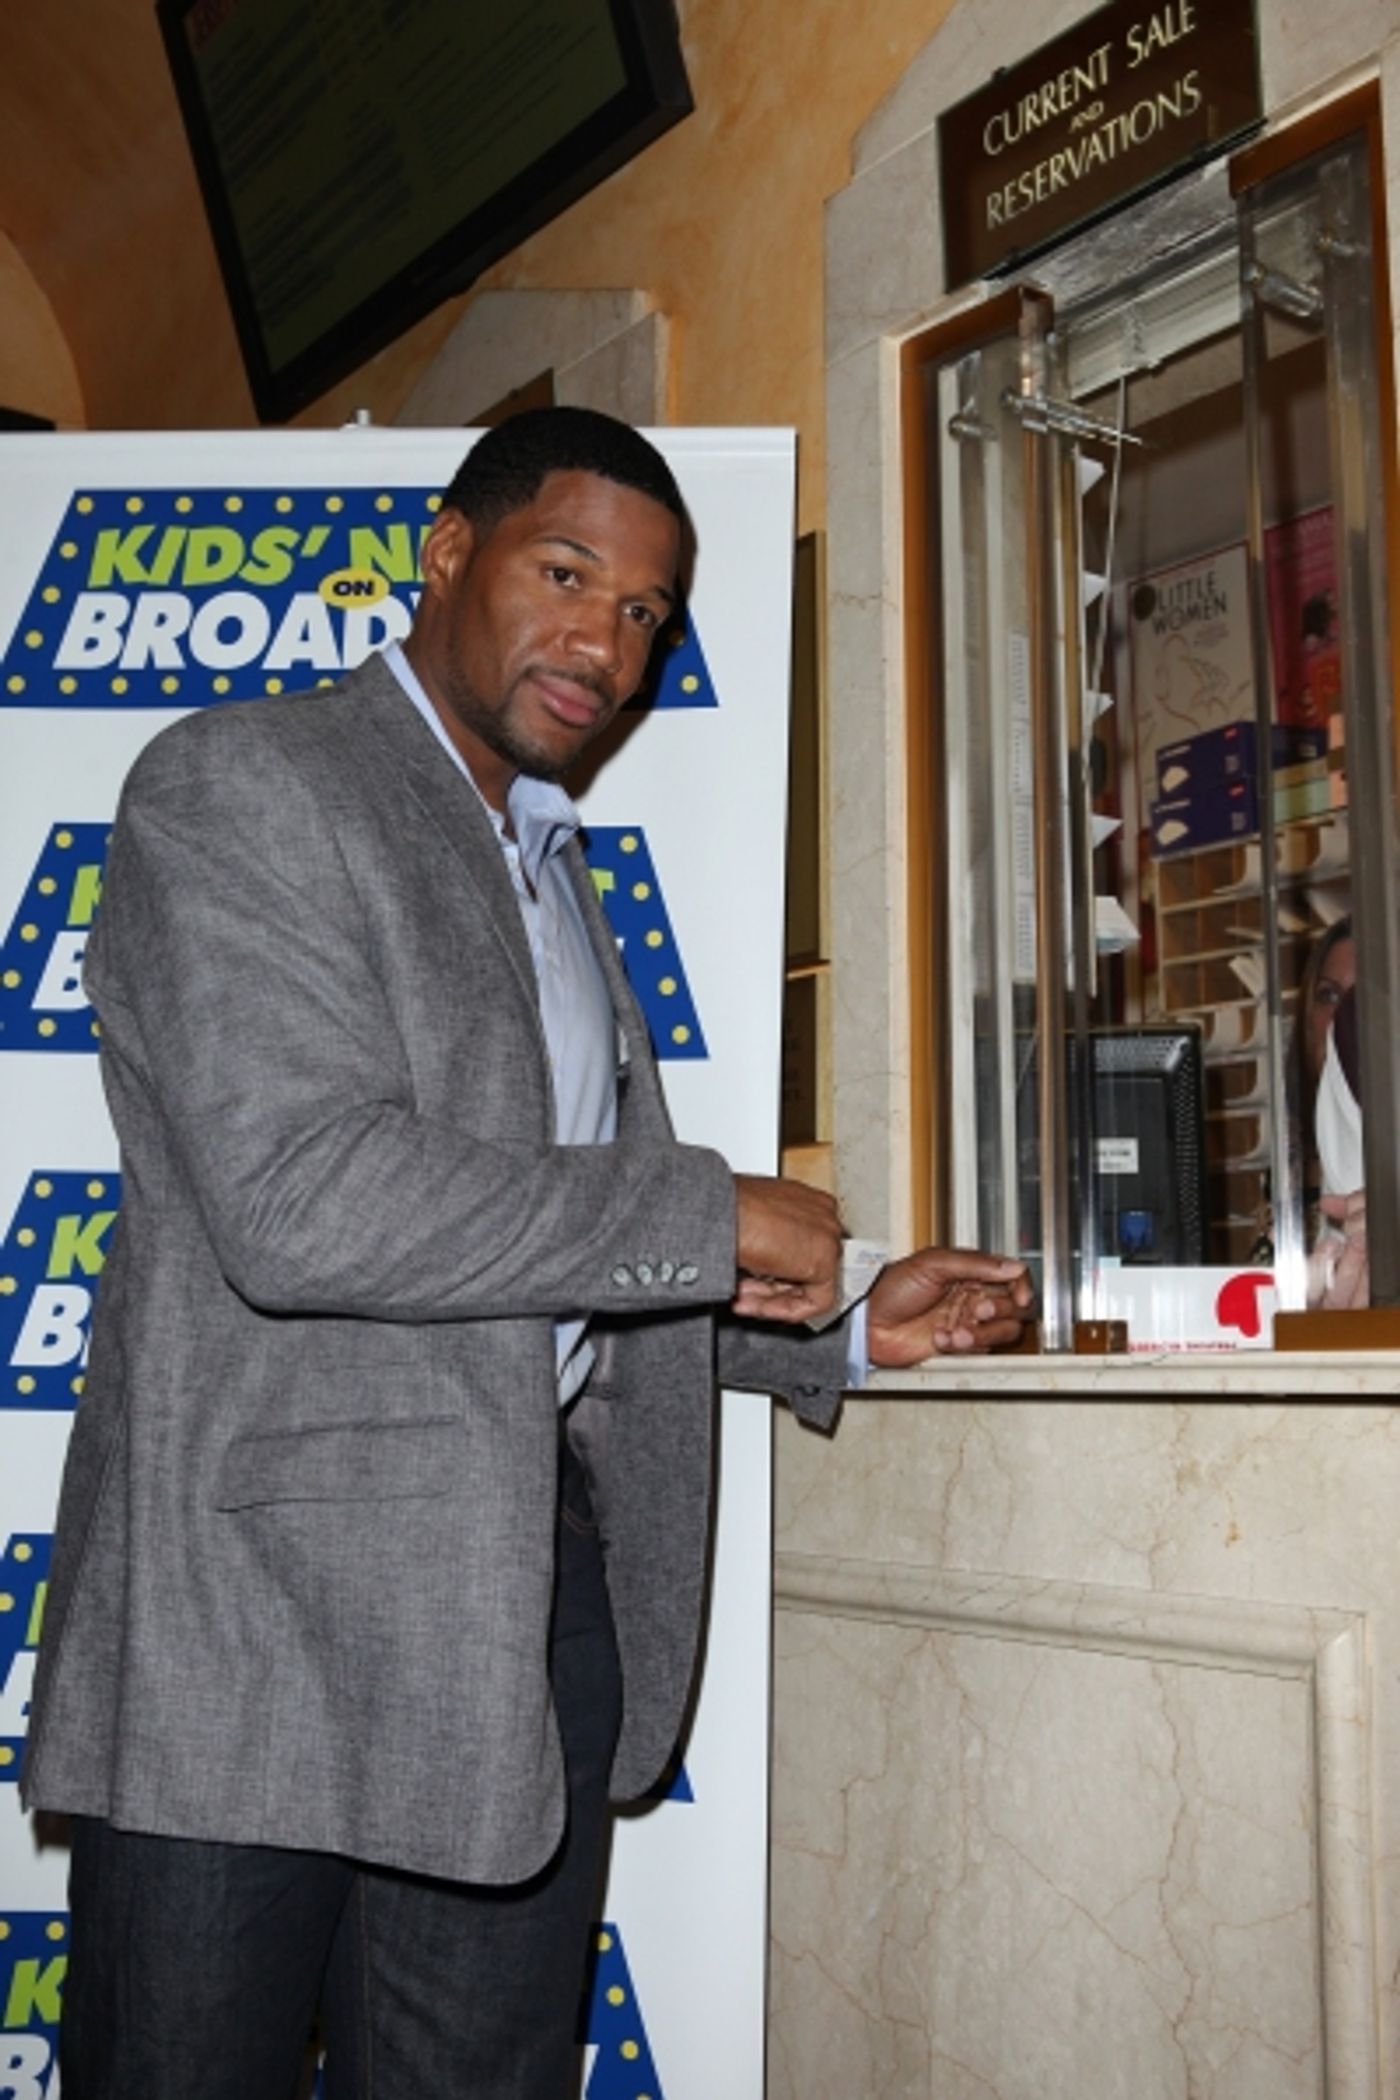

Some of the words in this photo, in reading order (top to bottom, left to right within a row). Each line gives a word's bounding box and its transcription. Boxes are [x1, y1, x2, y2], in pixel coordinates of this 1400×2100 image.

[983, 43, 1112, 156] CURRENT
[1126, 1, 1196, 68] SALE
[1070, 102, 1105, 134] AND
[986, 70, 1202, 230] RESERVATIONS
[88, 524, 332, 588] KIDS'
[332, 580, 374, 597] ON
[1157, 570, 1216, 610] LITTLE
[1152, 593, 1227, 635] WOMEN
